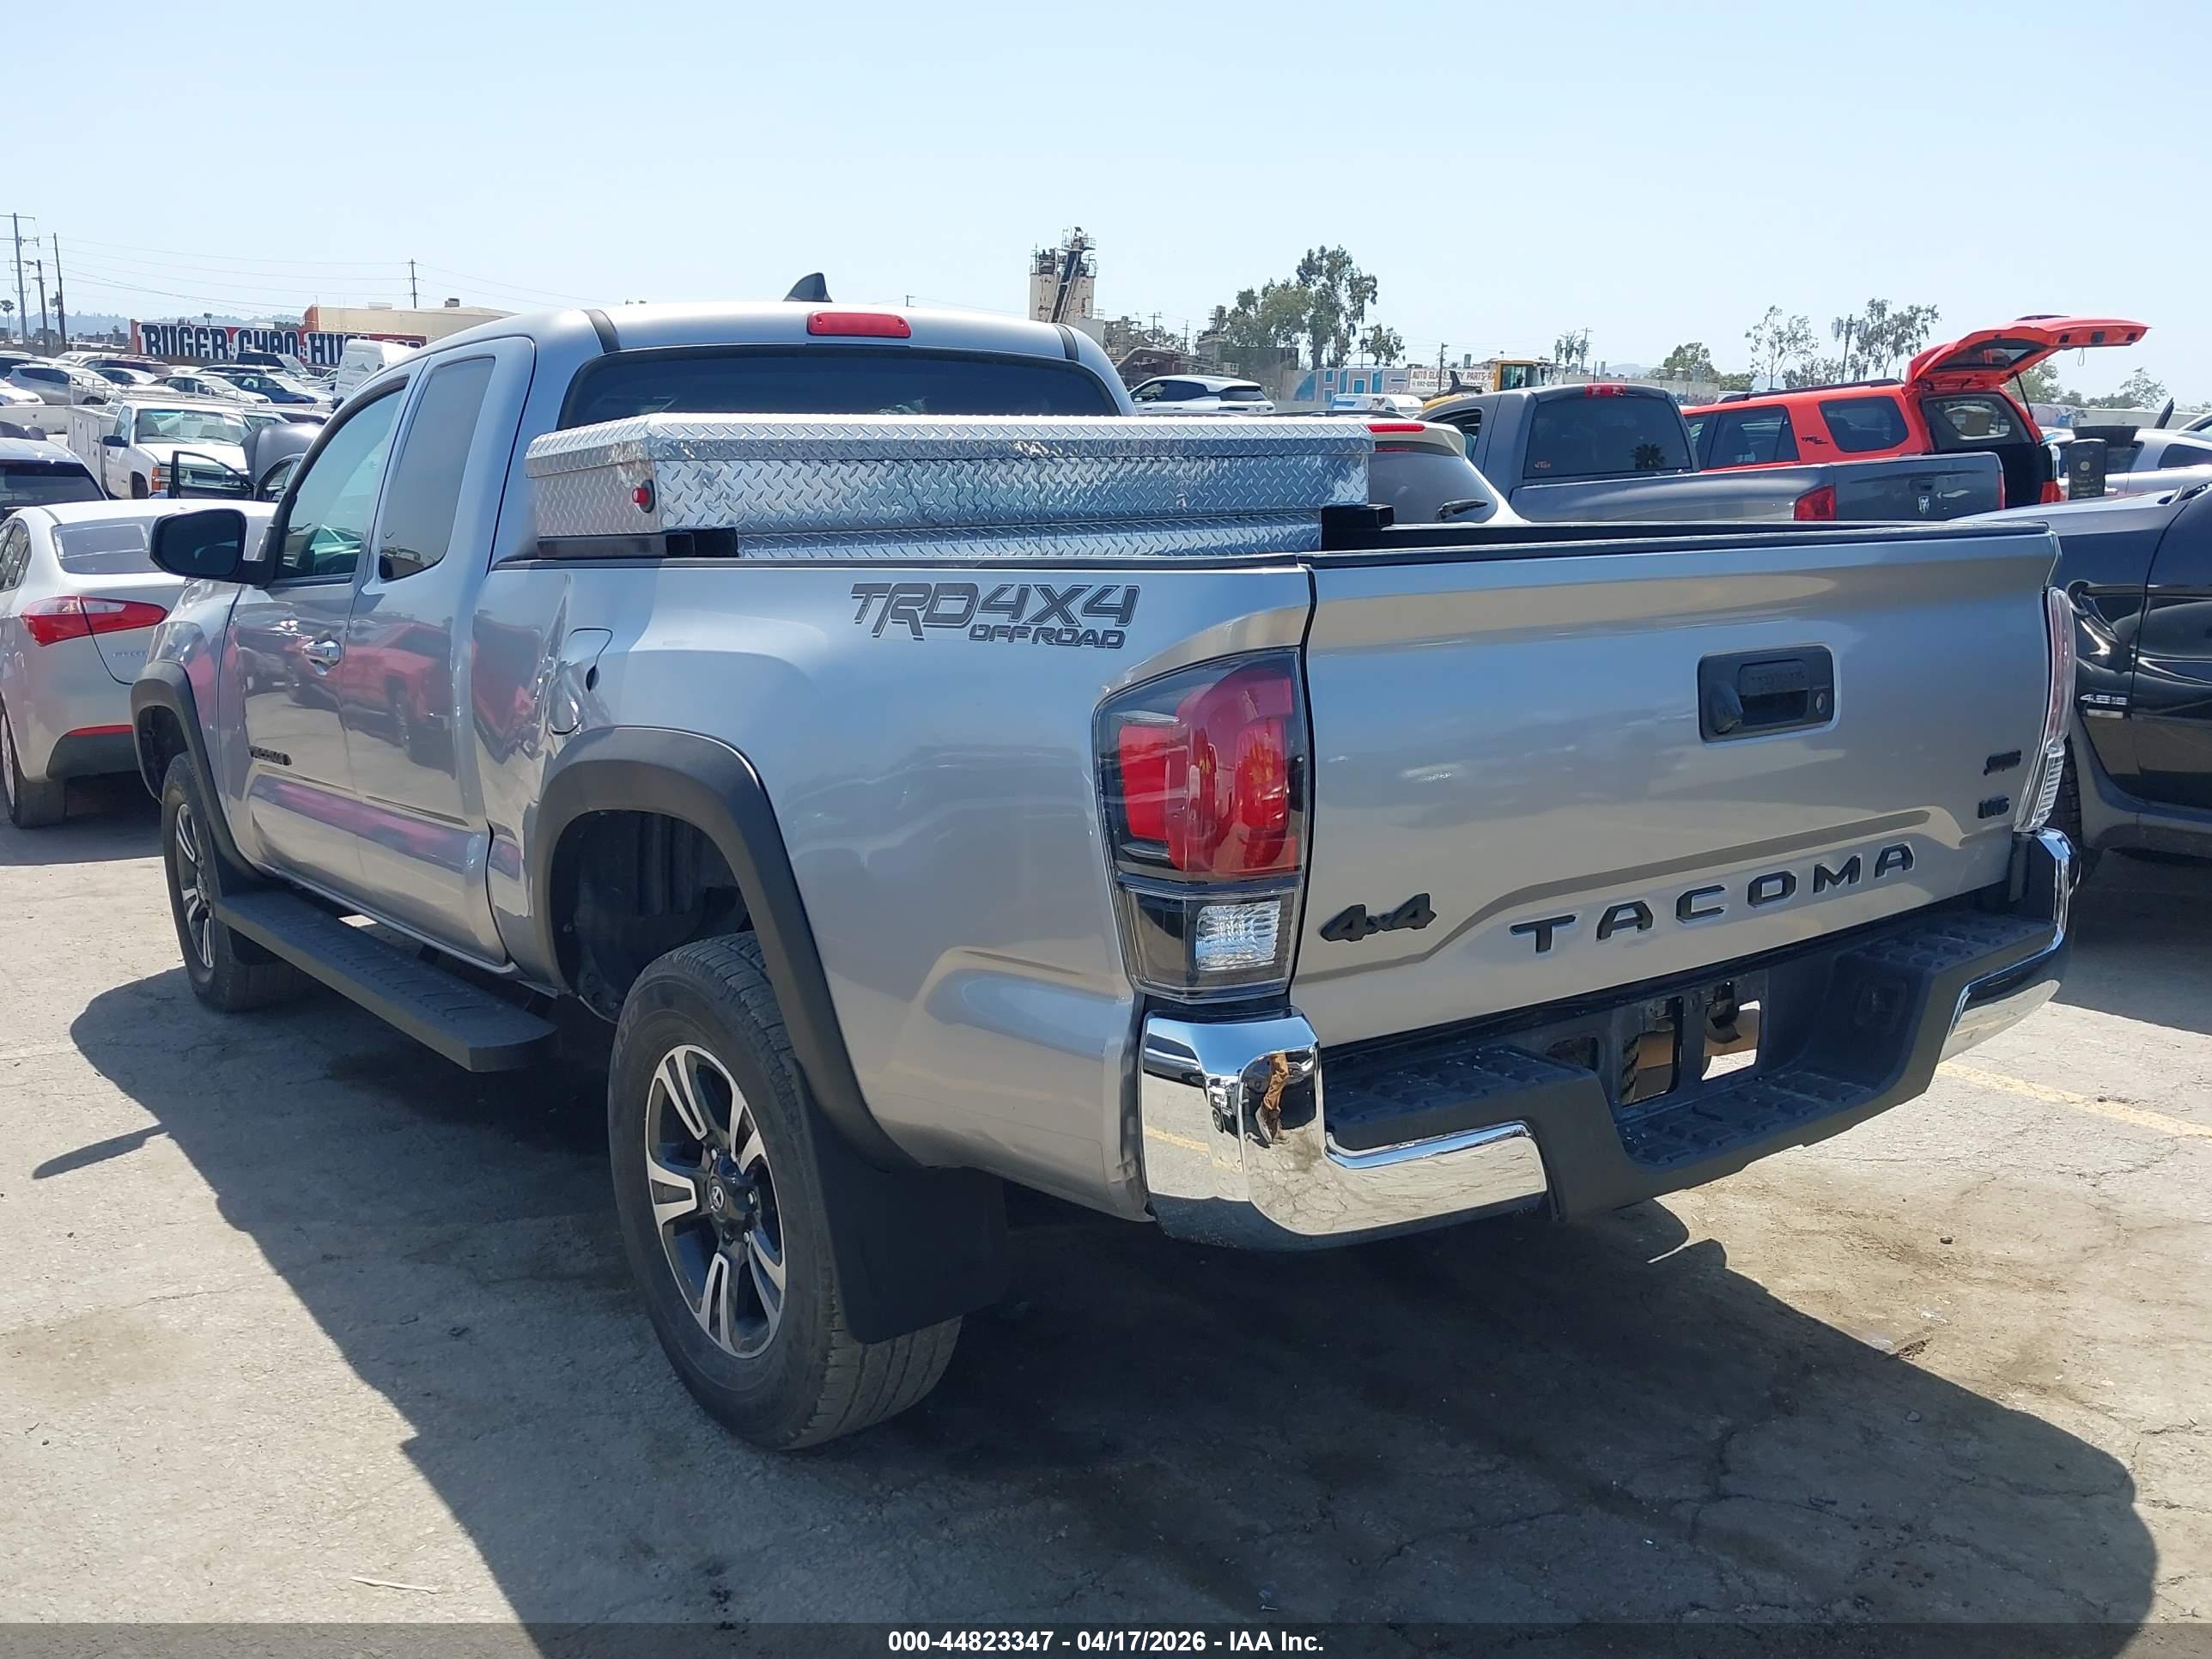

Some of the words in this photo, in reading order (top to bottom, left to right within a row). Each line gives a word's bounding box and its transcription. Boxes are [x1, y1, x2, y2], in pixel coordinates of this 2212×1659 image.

[1413, 371, 1427, 380] AUTO
[851, 582, 980, 641] TRD
[968, 623, 1033, 643] OFF
[1031, 626, 1127, 649] ROAD
[1509, 842, 1915, 955] TACOMA
